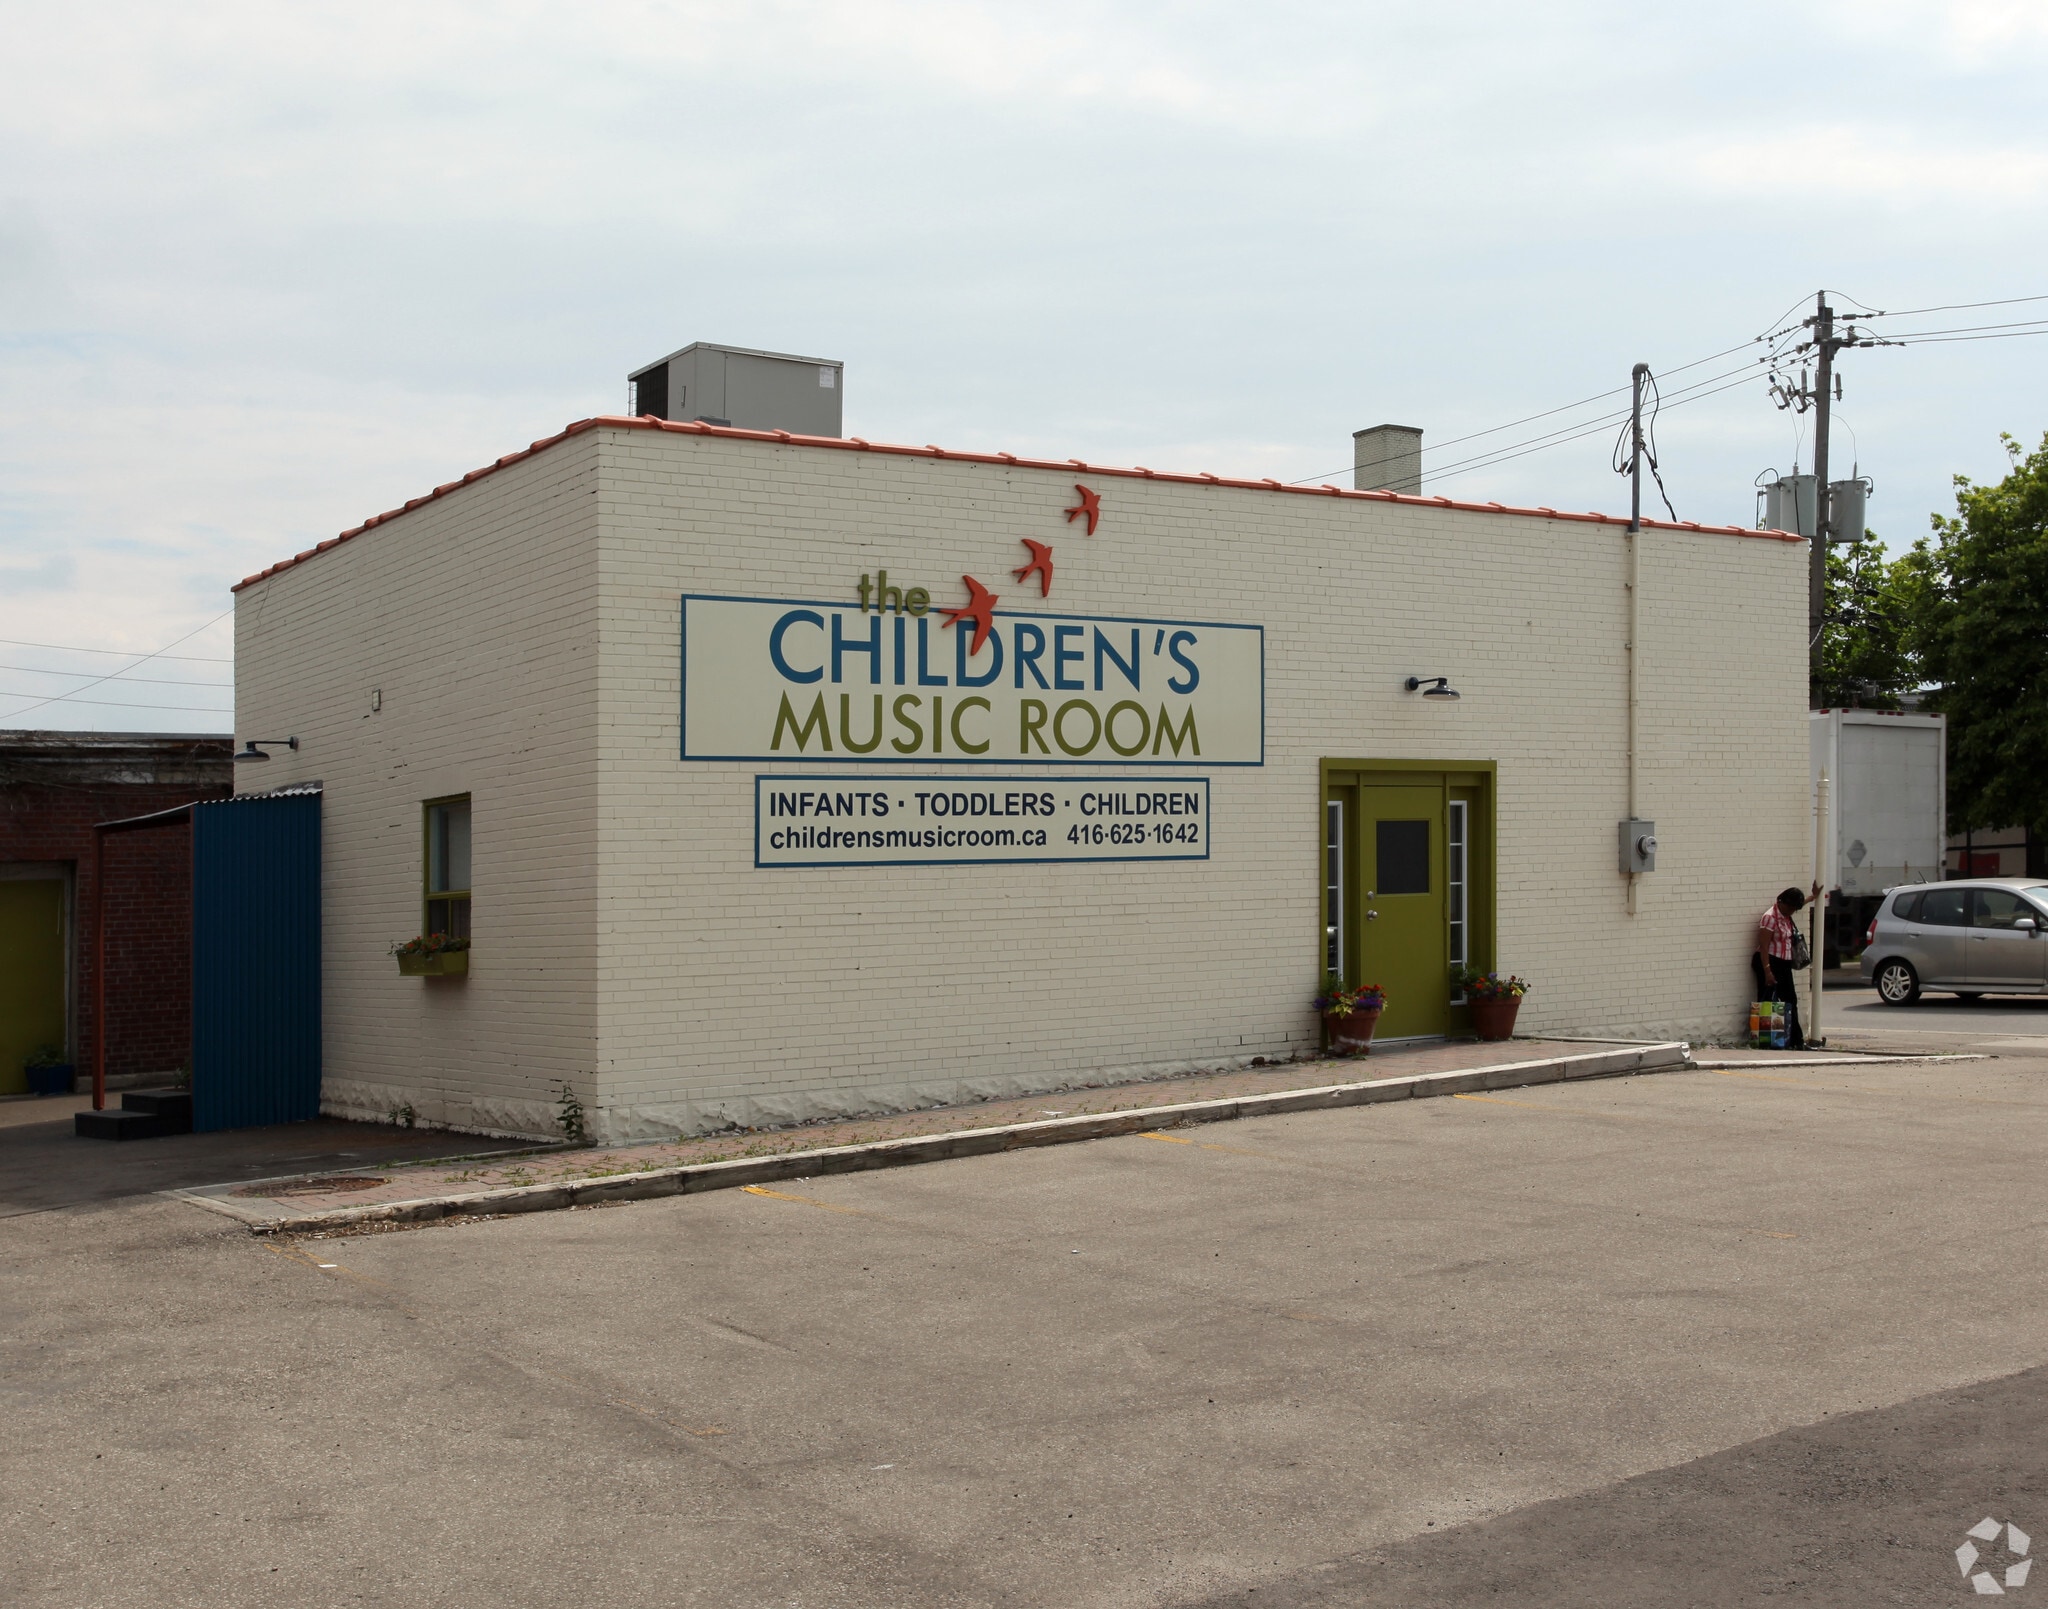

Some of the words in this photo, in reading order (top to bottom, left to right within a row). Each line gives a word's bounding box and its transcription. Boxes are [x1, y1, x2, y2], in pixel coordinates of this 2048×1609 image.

[858, 570, 930, 616] the
[769, 610, 1200, 694] CHILDREN'S
[770, 690, 991, 754] MUSIC
[1020, 699, 1200, 758] ROOM
[770, 793, 889, 816] INFANTS
[914, 793, 1055, 817] TODDLERS
[1080, 793, 1198, 815] CHILDREN
[770, 825, 1047, 850] childrensmusicroom.ca
